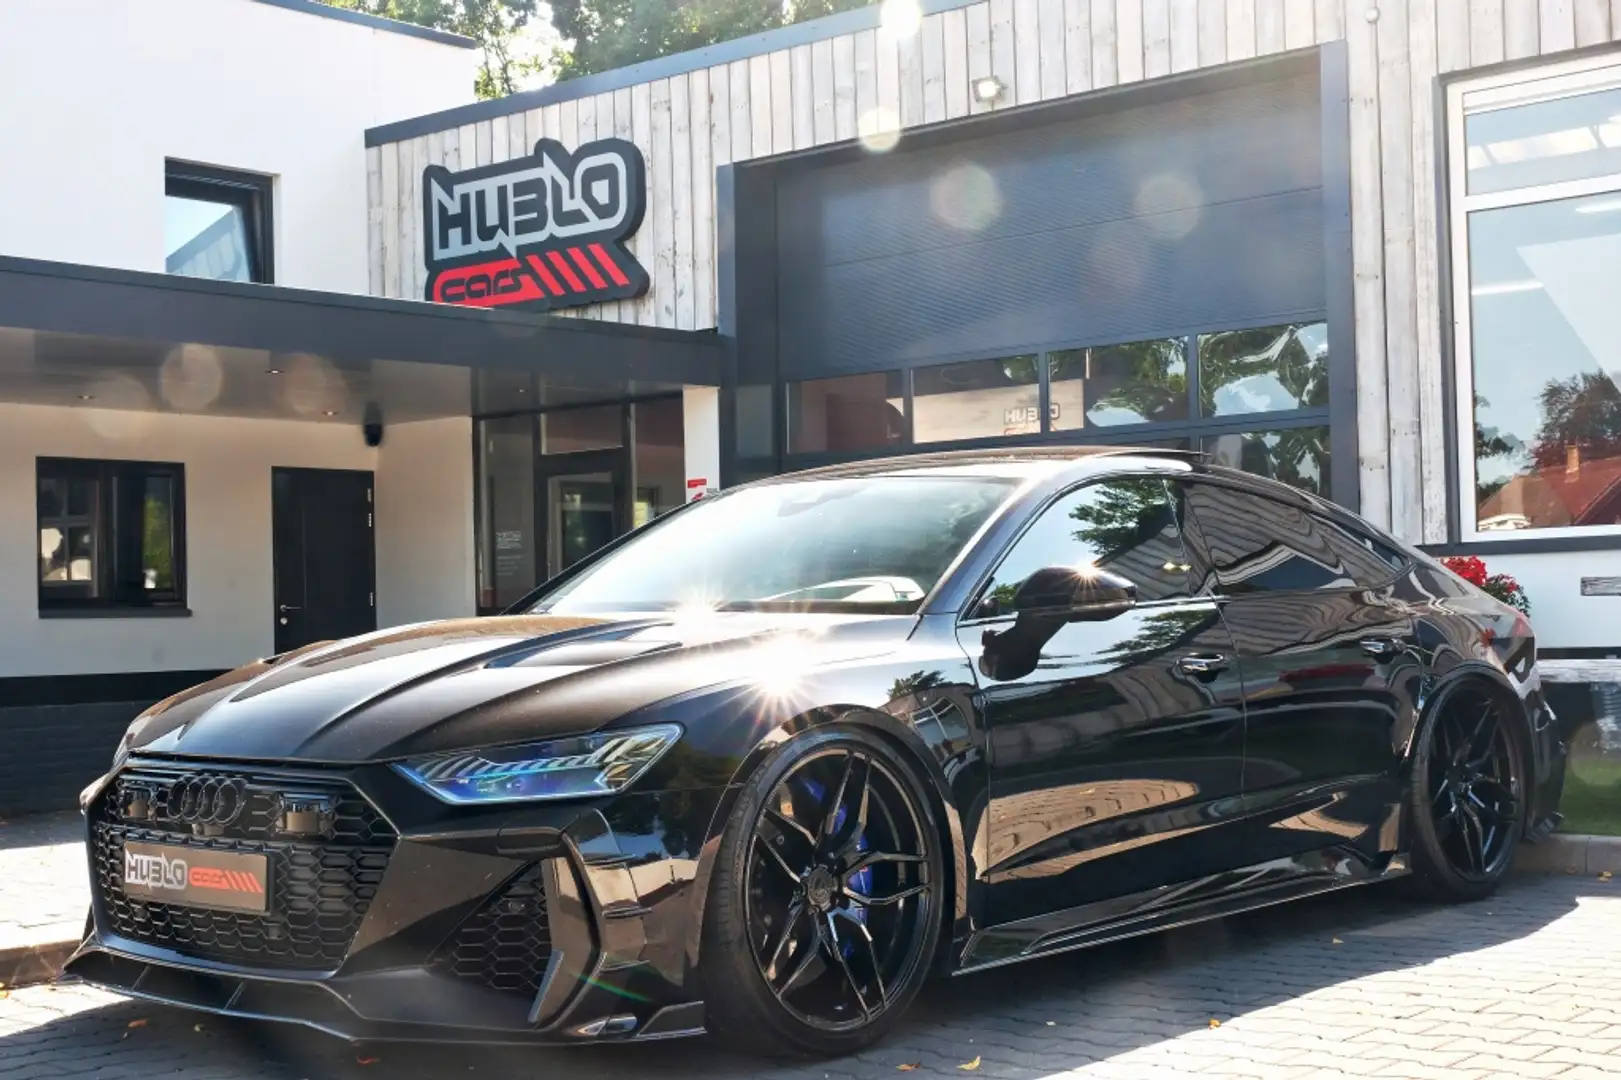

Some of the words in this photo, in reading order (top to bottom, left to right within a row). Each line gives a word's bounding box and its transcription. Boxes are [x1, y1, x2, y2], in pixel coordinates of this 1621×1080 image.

[432, 153, 626, 259] HUBLO
[1004, 403, 1060, 425] HUBO
[125, 849, 188, 890] HUBLO
